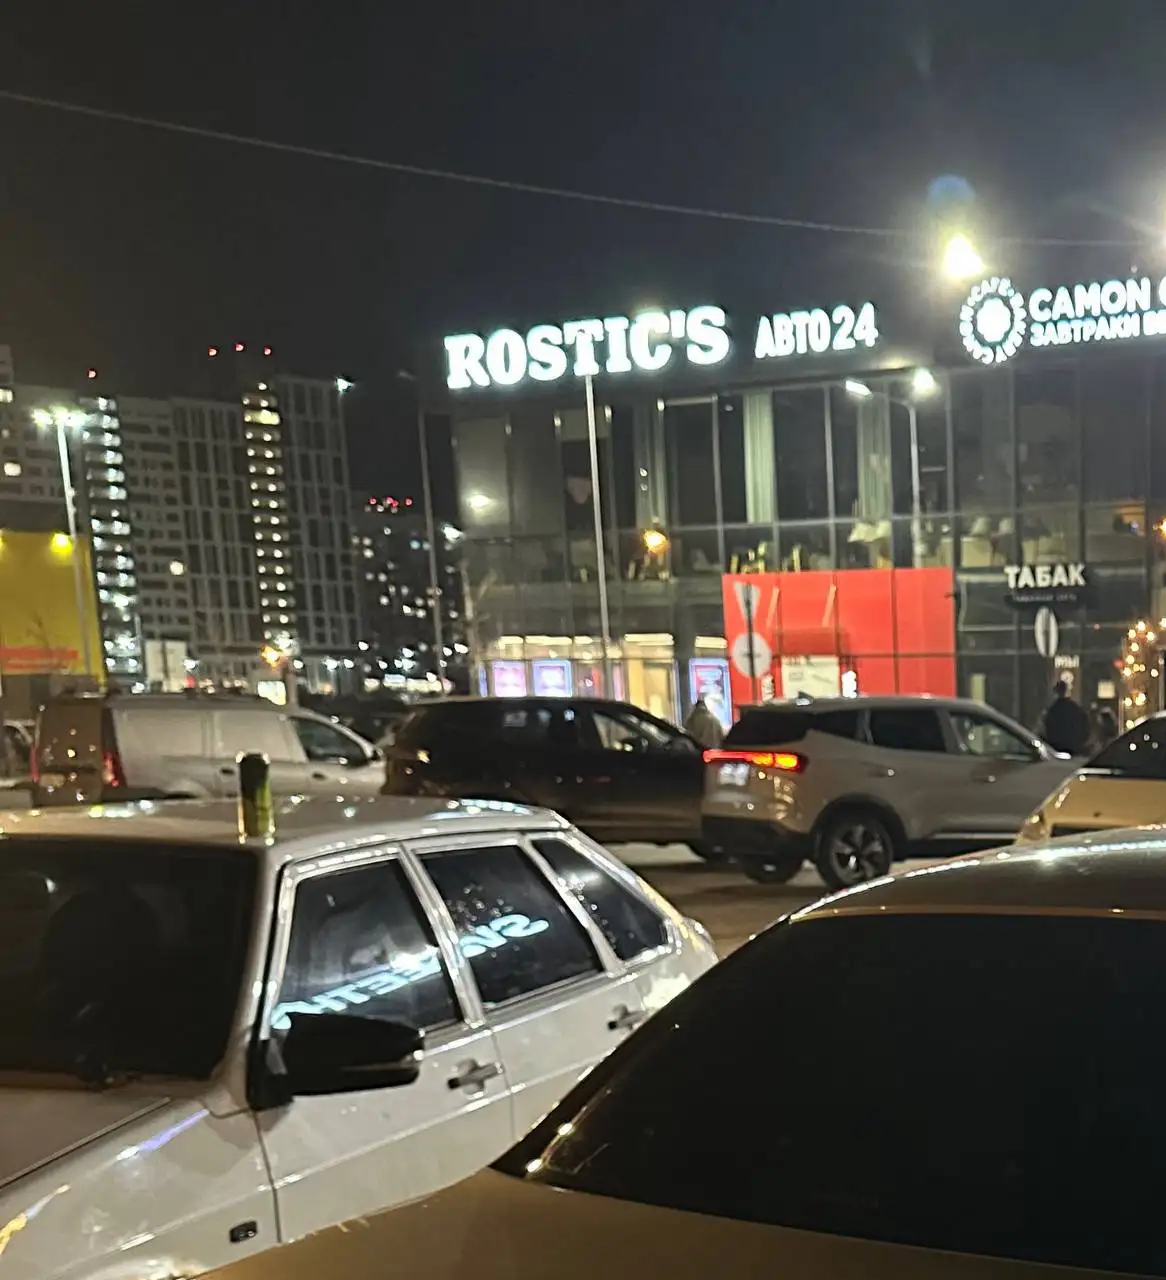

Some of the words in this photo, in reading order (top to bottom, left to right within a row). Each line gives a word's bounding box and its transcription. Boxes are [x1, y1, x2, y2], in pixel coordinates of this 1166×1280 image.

[1029, 277, 1150, 322] CAMON
[443, 305, 732, 390] ROSTIC'S
[1030, 313, 1141, 347] ЗАВТРАКИ
[1004, 563, 1087, 589] ТАБАК
